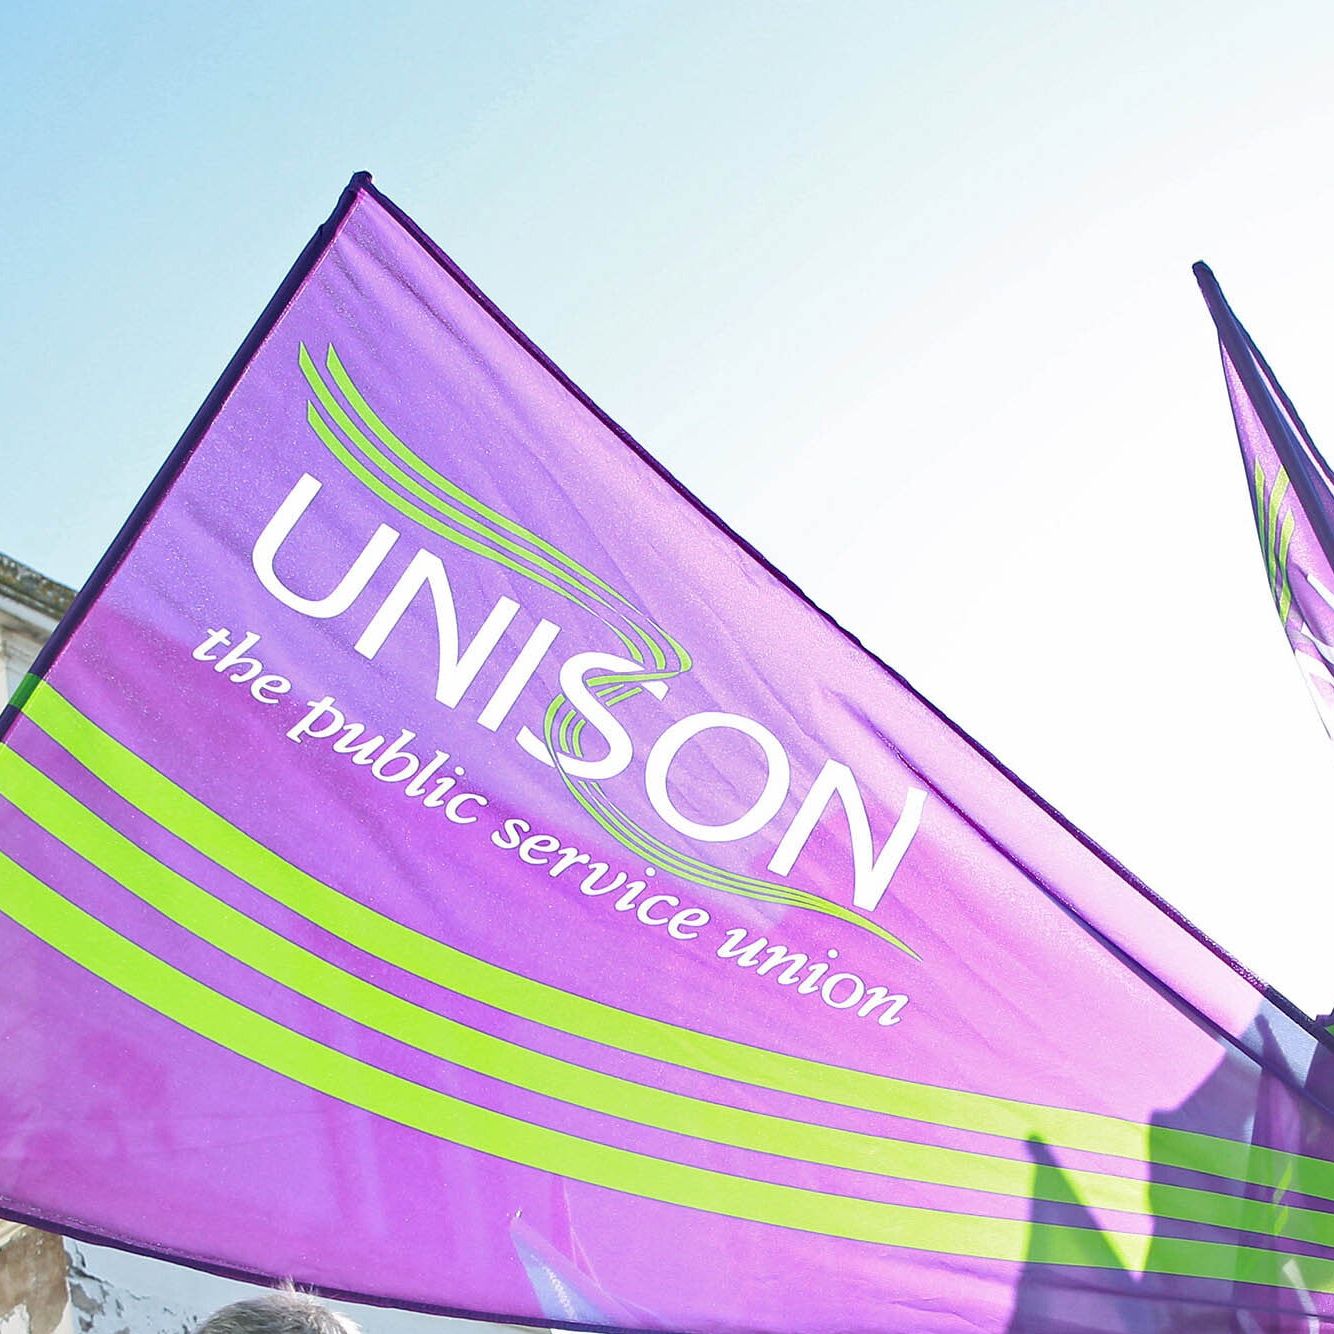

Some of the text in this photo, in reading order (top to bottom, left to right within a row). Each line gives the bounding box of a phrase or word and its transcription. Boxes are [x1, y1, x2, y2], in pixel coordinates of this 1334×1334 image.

[192, 622, 910, 1027] the public service union
[252, 472, 929, 912] UNISON
